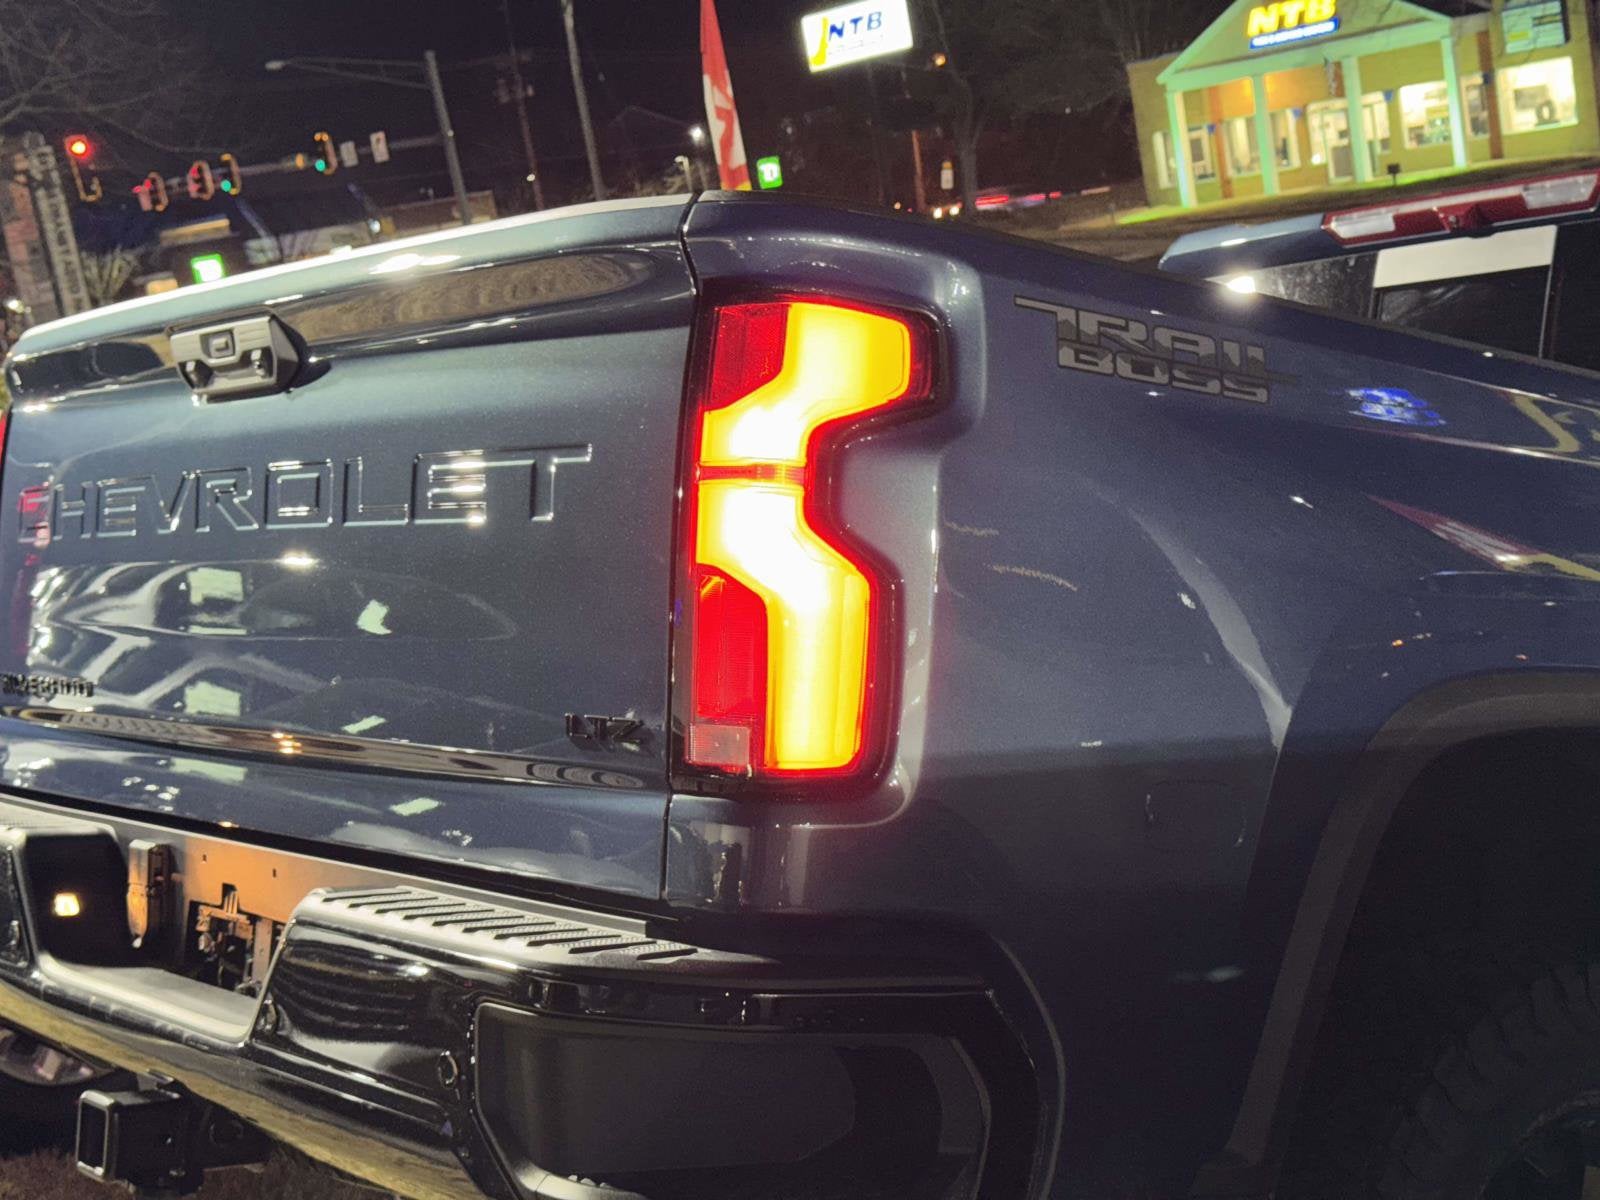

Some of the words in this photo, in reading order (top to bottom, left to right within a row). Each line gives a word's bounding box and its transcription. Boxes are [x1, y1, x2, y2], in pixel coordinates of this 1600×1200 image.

[828, 11, 882, 42] NTB
[1247, 0, 1337, 38] NTB
[1014, 294, 1290, 380] TRAIL
[1058, 340, 1269, 404] BOSS
[17, 442, 593, 547] CHEVROLET
[564, 712, 641, 745] LTZ
